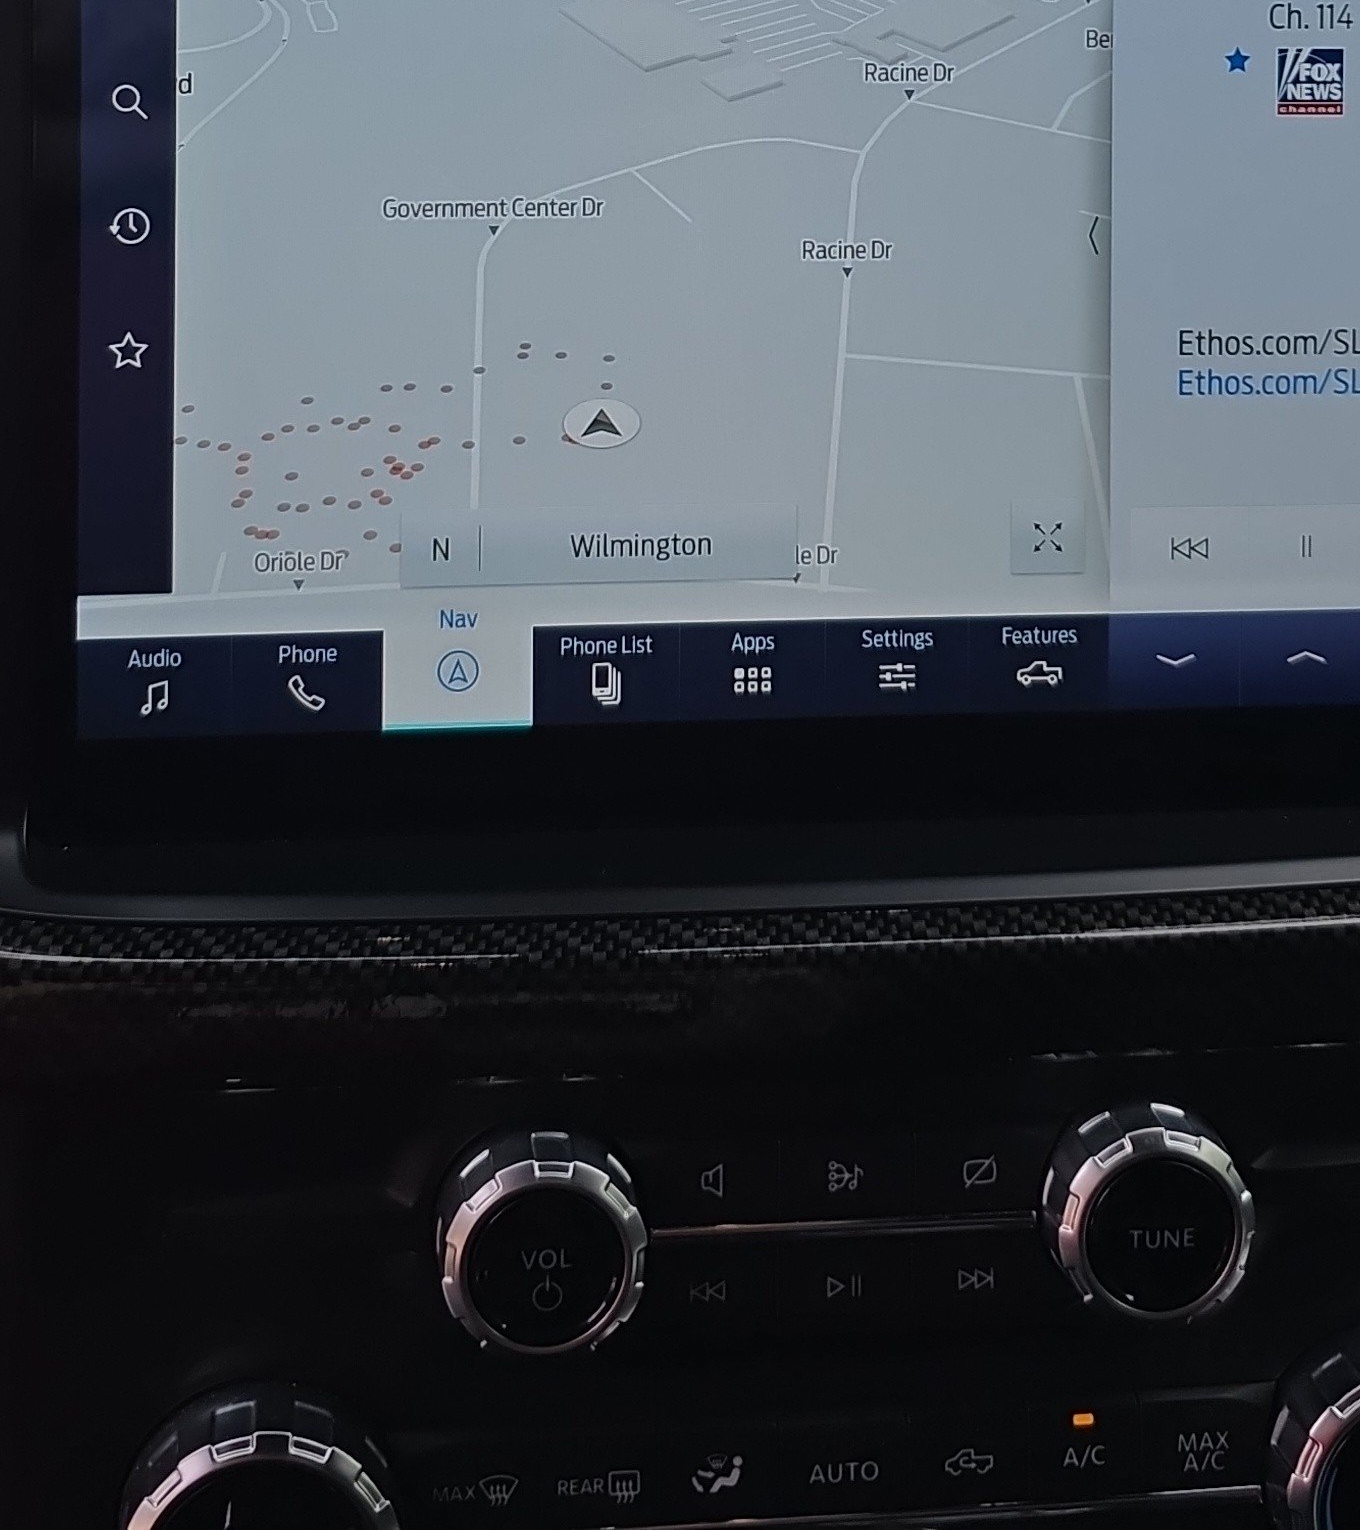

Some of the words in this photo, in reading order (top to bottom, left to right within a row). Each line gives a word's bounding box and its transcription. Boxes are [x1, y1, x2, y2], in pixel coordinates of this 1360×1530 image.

[1269, 3, 1311, 30] Ch.
[1317, 3, 1353, 30] 114
[865, 63, 929, 83] Racine
[933, 63, 954, 83] Dr
[1299, 63, 1341, 82] FOX
[1286, 83, 1342, 101] NEWS
[1279, 105, 1341, 113] channel
[383, 199, 508, 219] Government
[513, 198, 577, 218] Center
[582, 198, 604, 218] Dr
[803, 240, 866, 260] Racine
[871, 240, 892, 260] Dr
[432, 537, 450, 562] N
[570, 533, 713, 564] Wilmington
[817, 545, 838, 564] Dr
[254, 551, 315, 572] Oriole
[320, 551, 342, 570] Dr
[439, 610, 478, 630] Nav
[560, 636, 615, 657] Phone
[620, 635, 653, 655] List
[731, 633, 775, 657] Apps
[861, 628, 934, 651] Settings
[1001, 625, 1078, 646] Features
[128, 650, 182, 669] Audio
[278, 645, 337, 665] Phone
[1129, 1228, 1196, 1249] TUNE
[521, 1249, 572, 1270] VOL
[1178, 1431, 1230, 1452] MAX
[1063, 1446, 1106, 1468] A/C
[1183, 1451, 1225, 1472] A/C
[810, 1461, 880, 1484] AUTO
[432, 1483, 477, 1502] MAX
[557, 1478, 605, 1496] REAR
